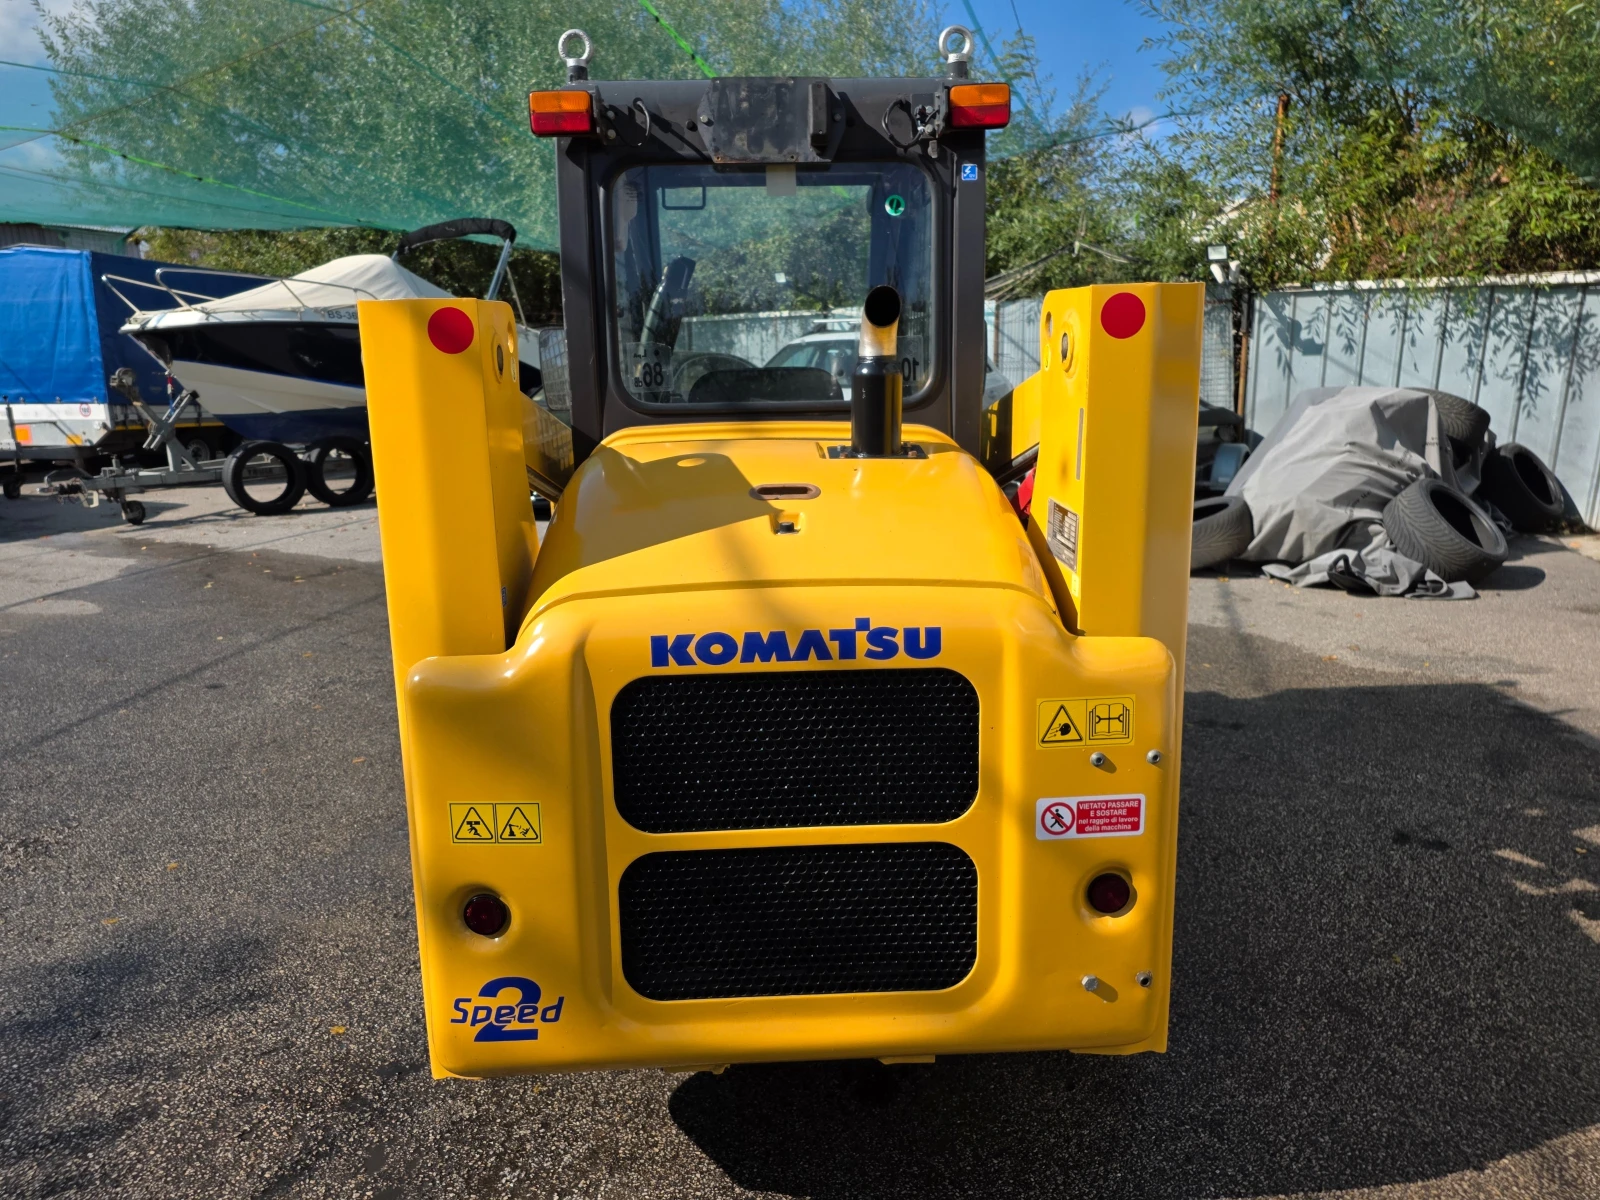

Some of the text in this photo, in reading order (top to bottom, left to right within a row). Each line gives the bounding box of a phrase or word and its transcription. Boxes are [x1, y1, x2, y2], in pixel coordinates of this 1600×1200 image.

[650, 617, 941, 667] KOMATSU
[1085, 824, 1100, 832] della
[450, 996, 565, 1027] Speed
[473, 976, 541, 1042] 2
